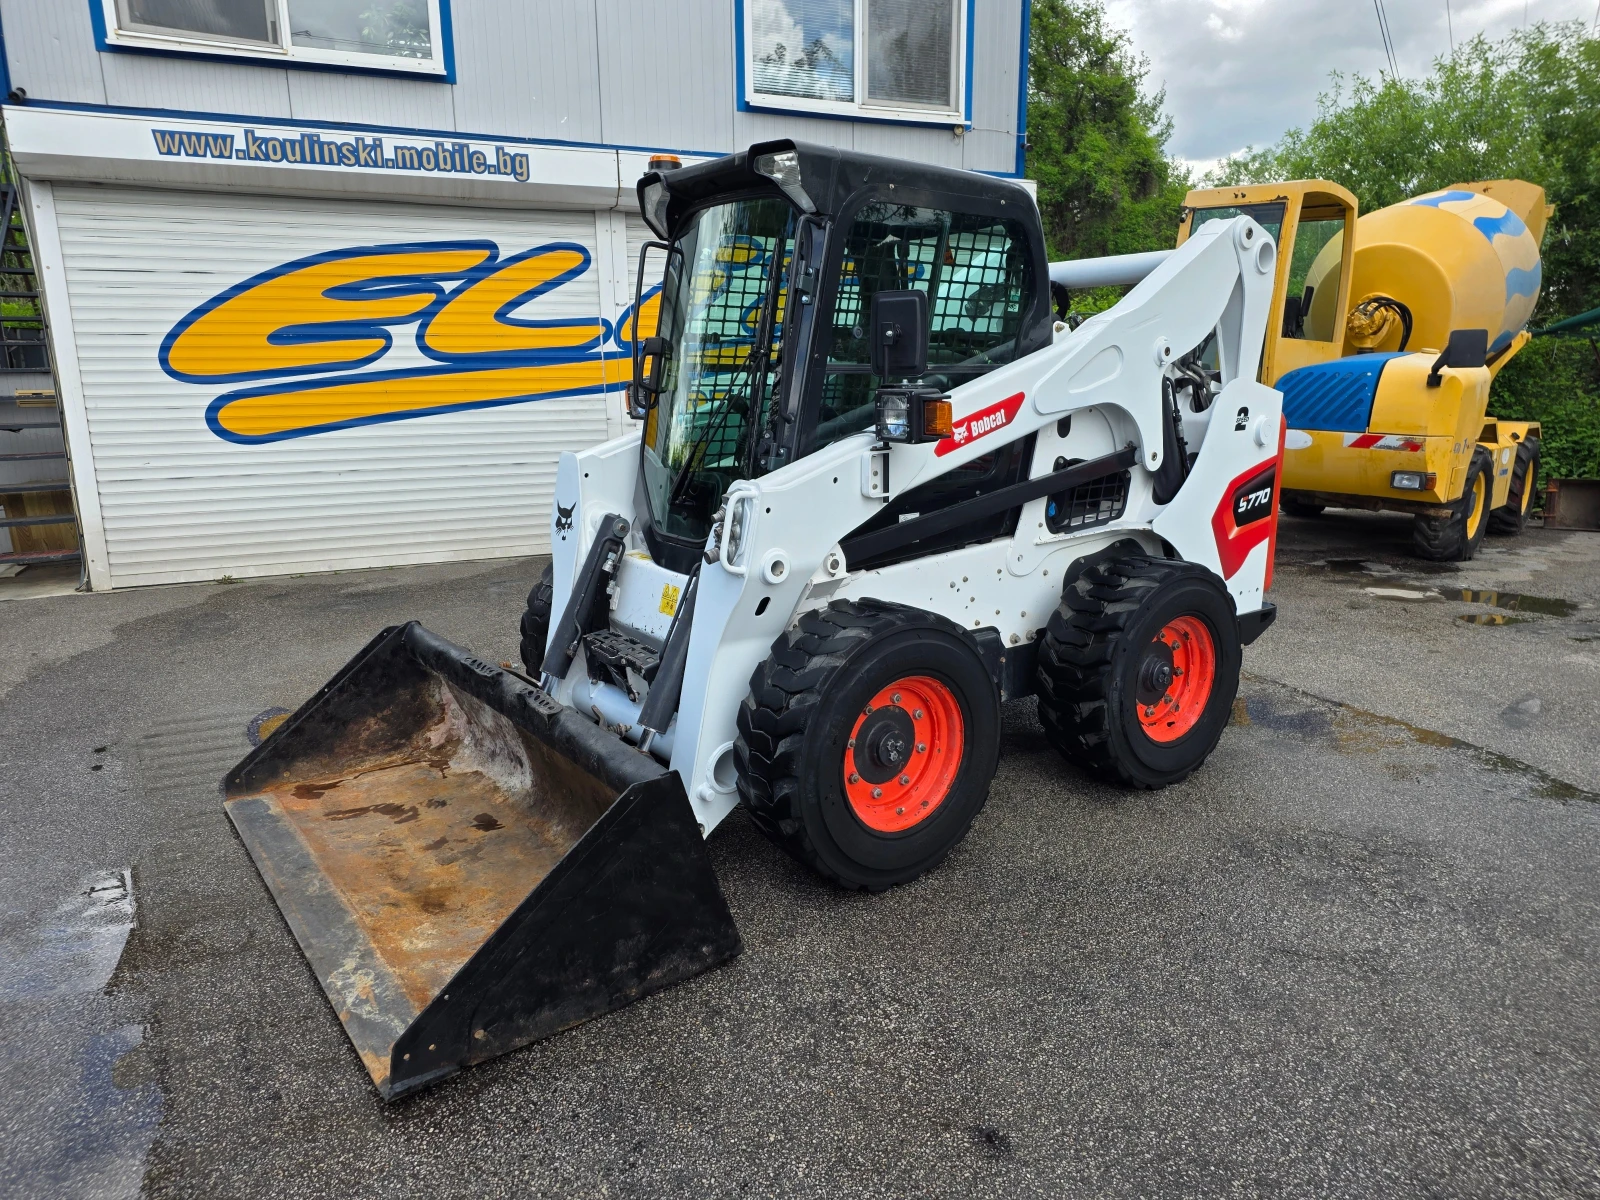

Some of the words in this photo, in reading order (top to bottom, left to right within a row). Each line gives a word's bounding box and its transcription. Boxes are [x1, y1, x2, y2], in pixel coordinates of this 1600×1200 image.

[151, 129, 530, 183] www.koulinski.mobile.bg
[970, 408, 1006, 437] Bobcat
[1234, 406, 1249, 431] 2
[1237, 487, 1271, 513] S770
